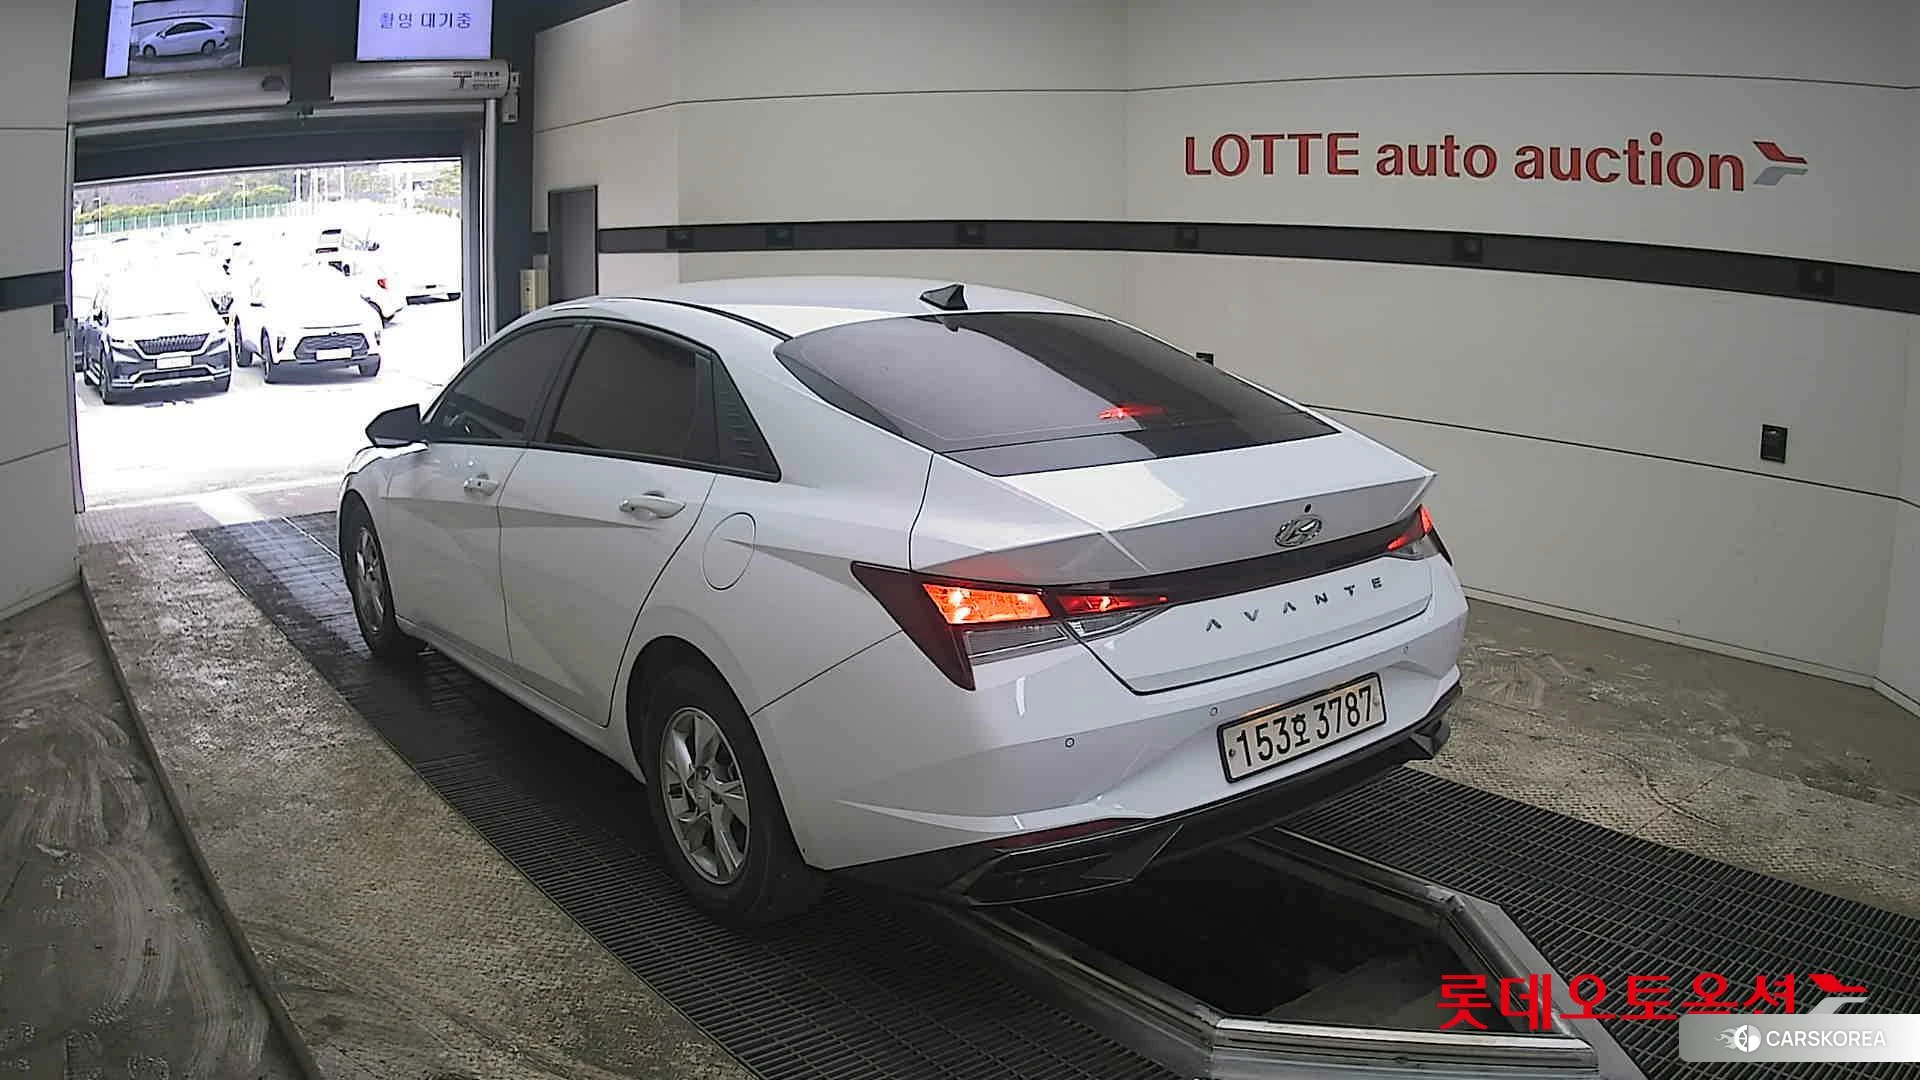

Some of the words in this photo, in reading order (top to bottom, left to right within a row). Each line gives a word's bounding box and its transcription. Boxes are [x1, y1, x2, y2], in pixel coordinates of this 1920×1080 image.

[420, 11, 472, 29] 대기중
[1185, 132, 1360, 177] LOTTE
[1376, 134, 1498, 178] auto
[1514, 132, 1745, 192] auction
[1205, 576, 1383, 632] AVANTE
[1236, 713, 1311, 768] 153호
[1313, 685, 1372, 740] 3787
